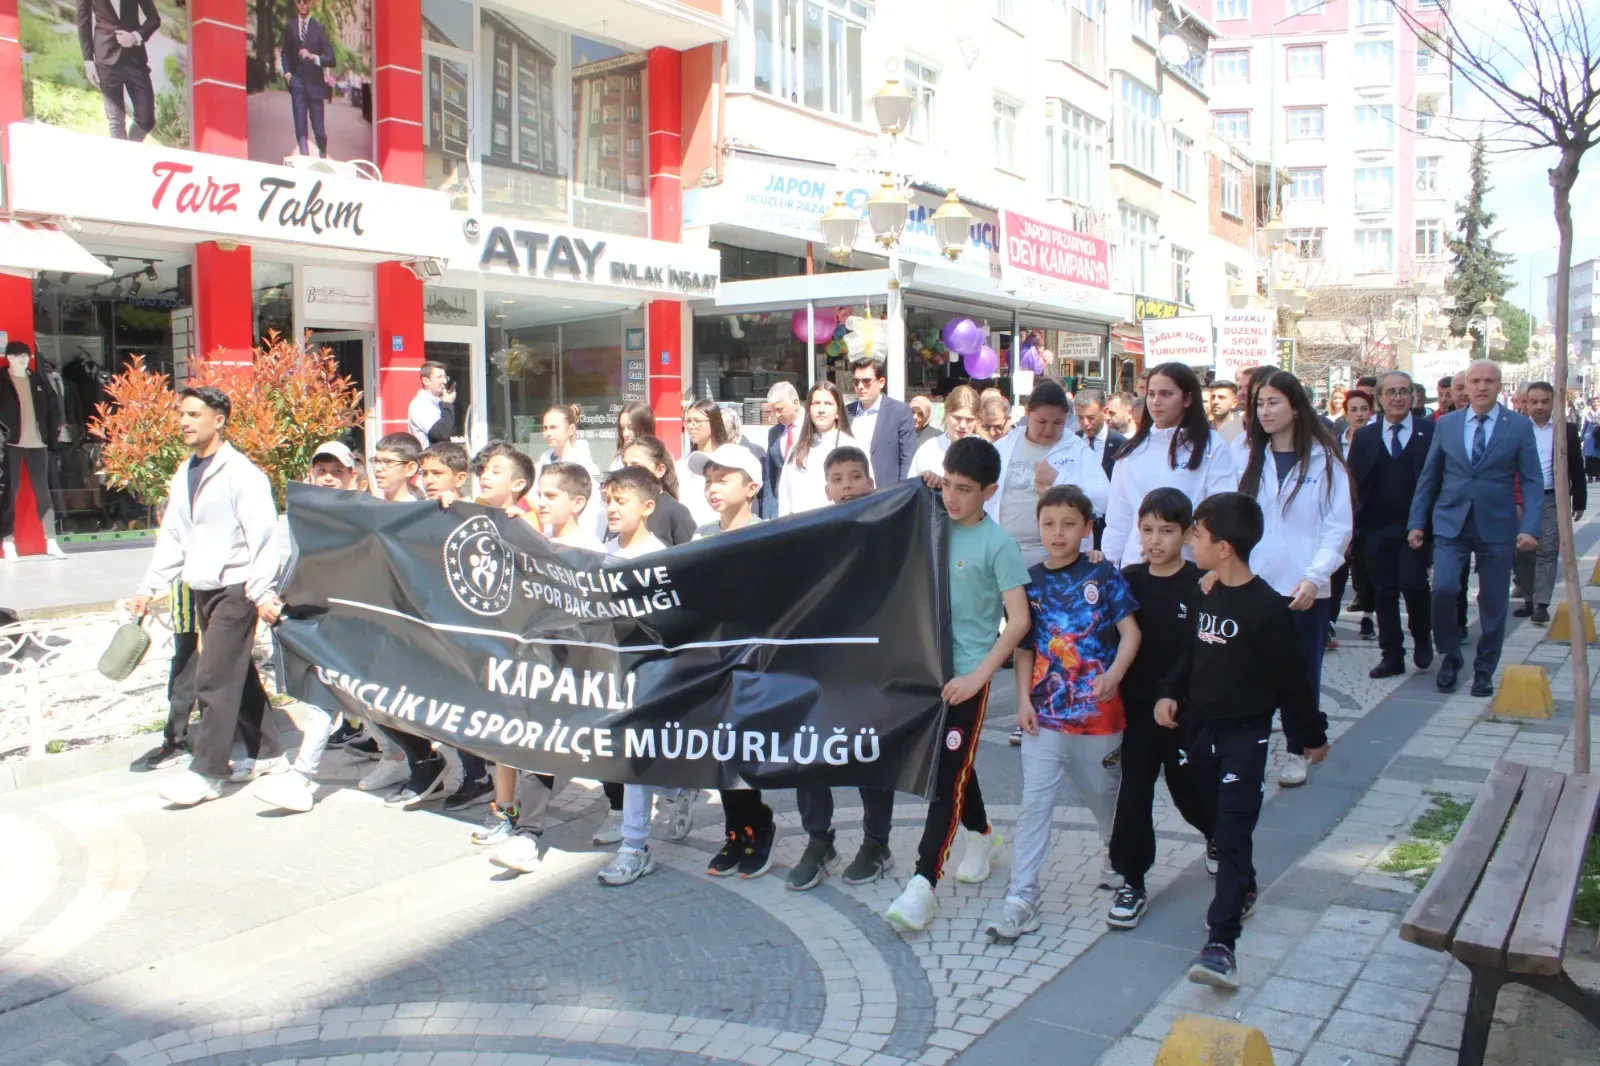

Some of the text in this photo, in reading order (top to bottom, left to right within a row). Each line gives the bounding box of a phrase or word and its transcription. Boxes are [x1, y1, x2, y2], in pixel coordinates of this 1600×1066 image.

[151, 161, 364, 236] Tarz Takım
[746, 193, 794, 209] UCUZLUK
[764, 175, 826, 200] JAPON
[1021, 221, 1051, 243] JAPON
[479, 226, 606, 281] ATAY
[610, 261, 664, 286] EMLAK
[1009, 236, 1037, 266] DEV
[1040, 245, 1108, 286] KAMPANYA
[1231, 337, 1258, 346] SPOR
[547, 563, 628, 596] GENÇLİK
[633, 566, 671, 585] VE
[521, 580, 681, 618] SPOR BAKANLIĞI
[488, 657, 636, 710] KAPAKLI
[426, 699, 466, 733] VE
[463, 710, 544, 749] SPOR
[544, 717, 614, 762] İLÇE
[624, 721, 881, 765] MÜDÜRLÜĞÜ
